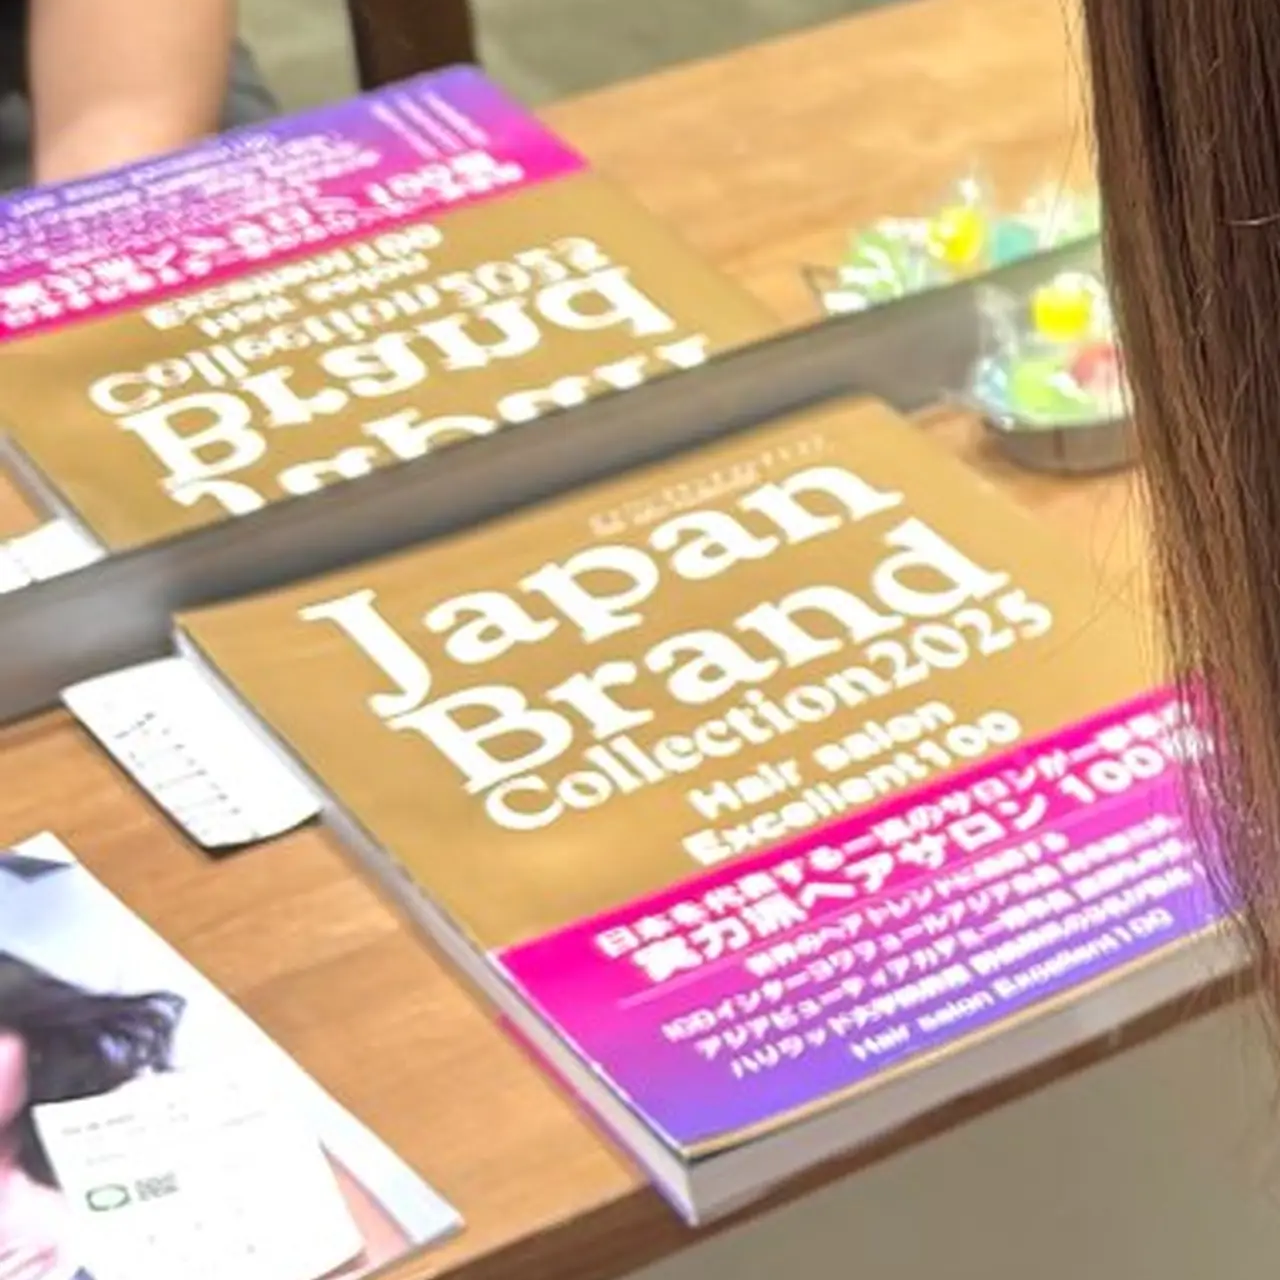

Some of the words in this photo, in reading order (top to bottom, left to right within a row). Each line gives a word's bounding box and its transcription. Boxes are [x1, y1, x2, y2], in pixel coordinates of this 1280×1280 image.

[301, 464, 905, 718] Japan
[388, 516, 1011, 796] Brand
[485, 587, 1053, 832] Collection2025
[681, 710, 1022, 867] Excellent100
[686, 757, 802, 820] Hair
[812, 700, 957, 773] salon
[630, 793, 1049, 983] 実力派ヘアサロン
